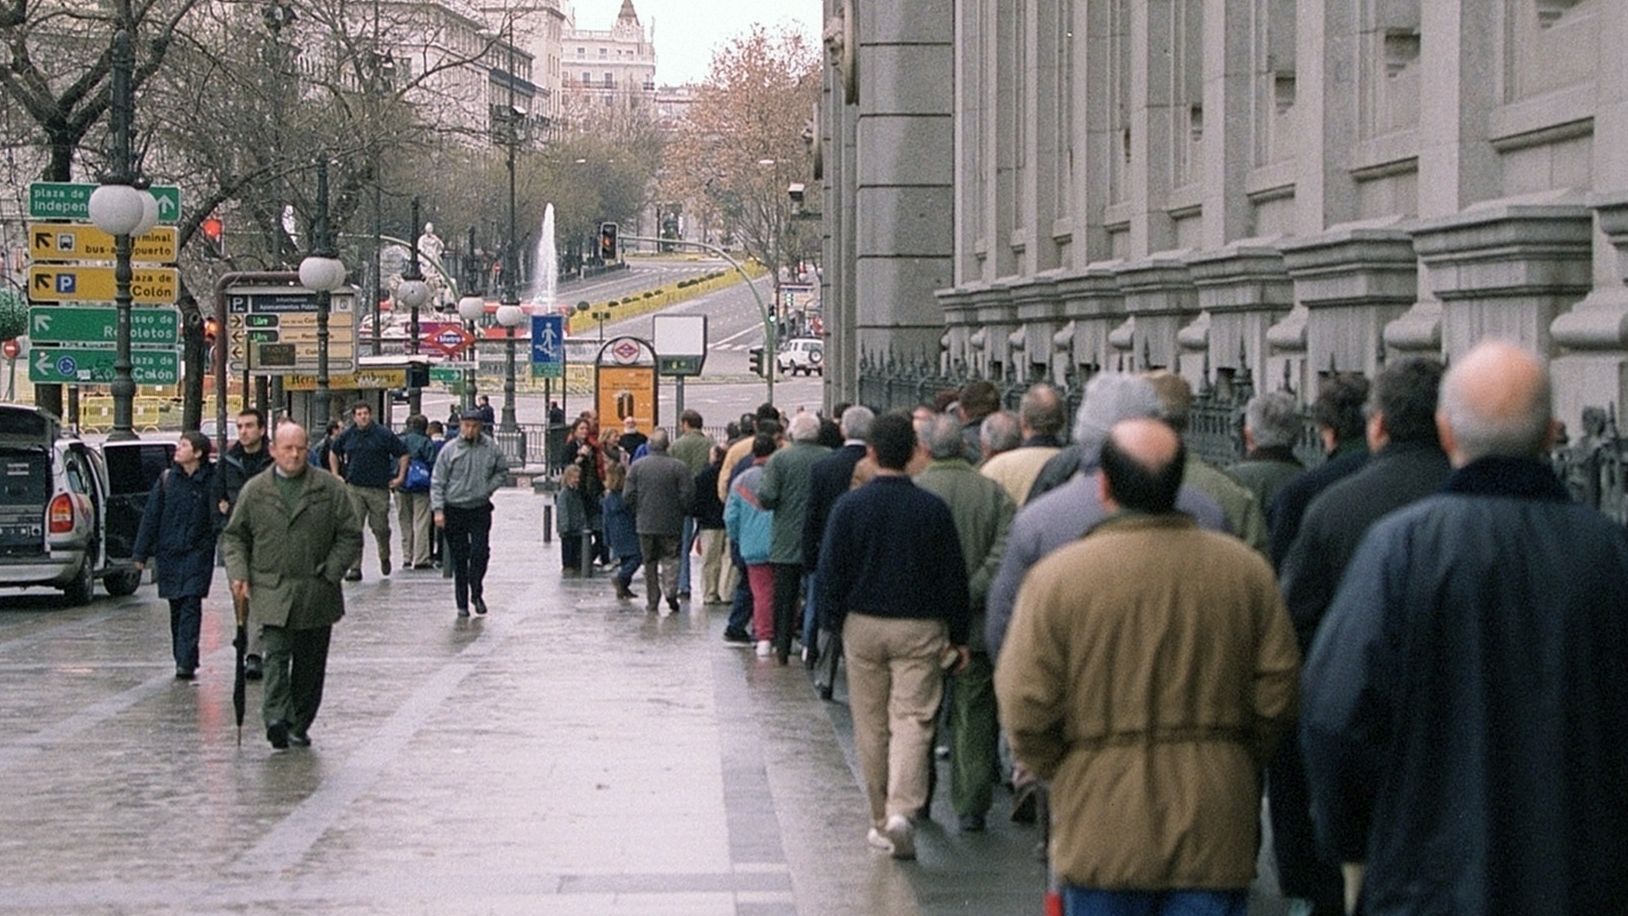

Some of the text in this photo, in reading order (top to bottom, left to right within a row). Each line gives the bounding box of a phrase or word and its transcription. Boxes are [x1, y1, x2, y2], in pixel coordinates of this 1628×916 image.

[34, 188, 65, 199] plaza
[70, 188, 85, 199] de
[34, 200, 87, 214] Indepen
[136, 232, 172, 242] rminal
[85, 244, 172, 256] bus-apuerto
[134, 274, 172, 283] aza de
[132, 284, 172, 297] Colón
[130, 316, 155, 324] seo
[159, 315, 174, 324] de
[130, 354, 174, 365] laza de
[133, 367, 174, 380] Colón
